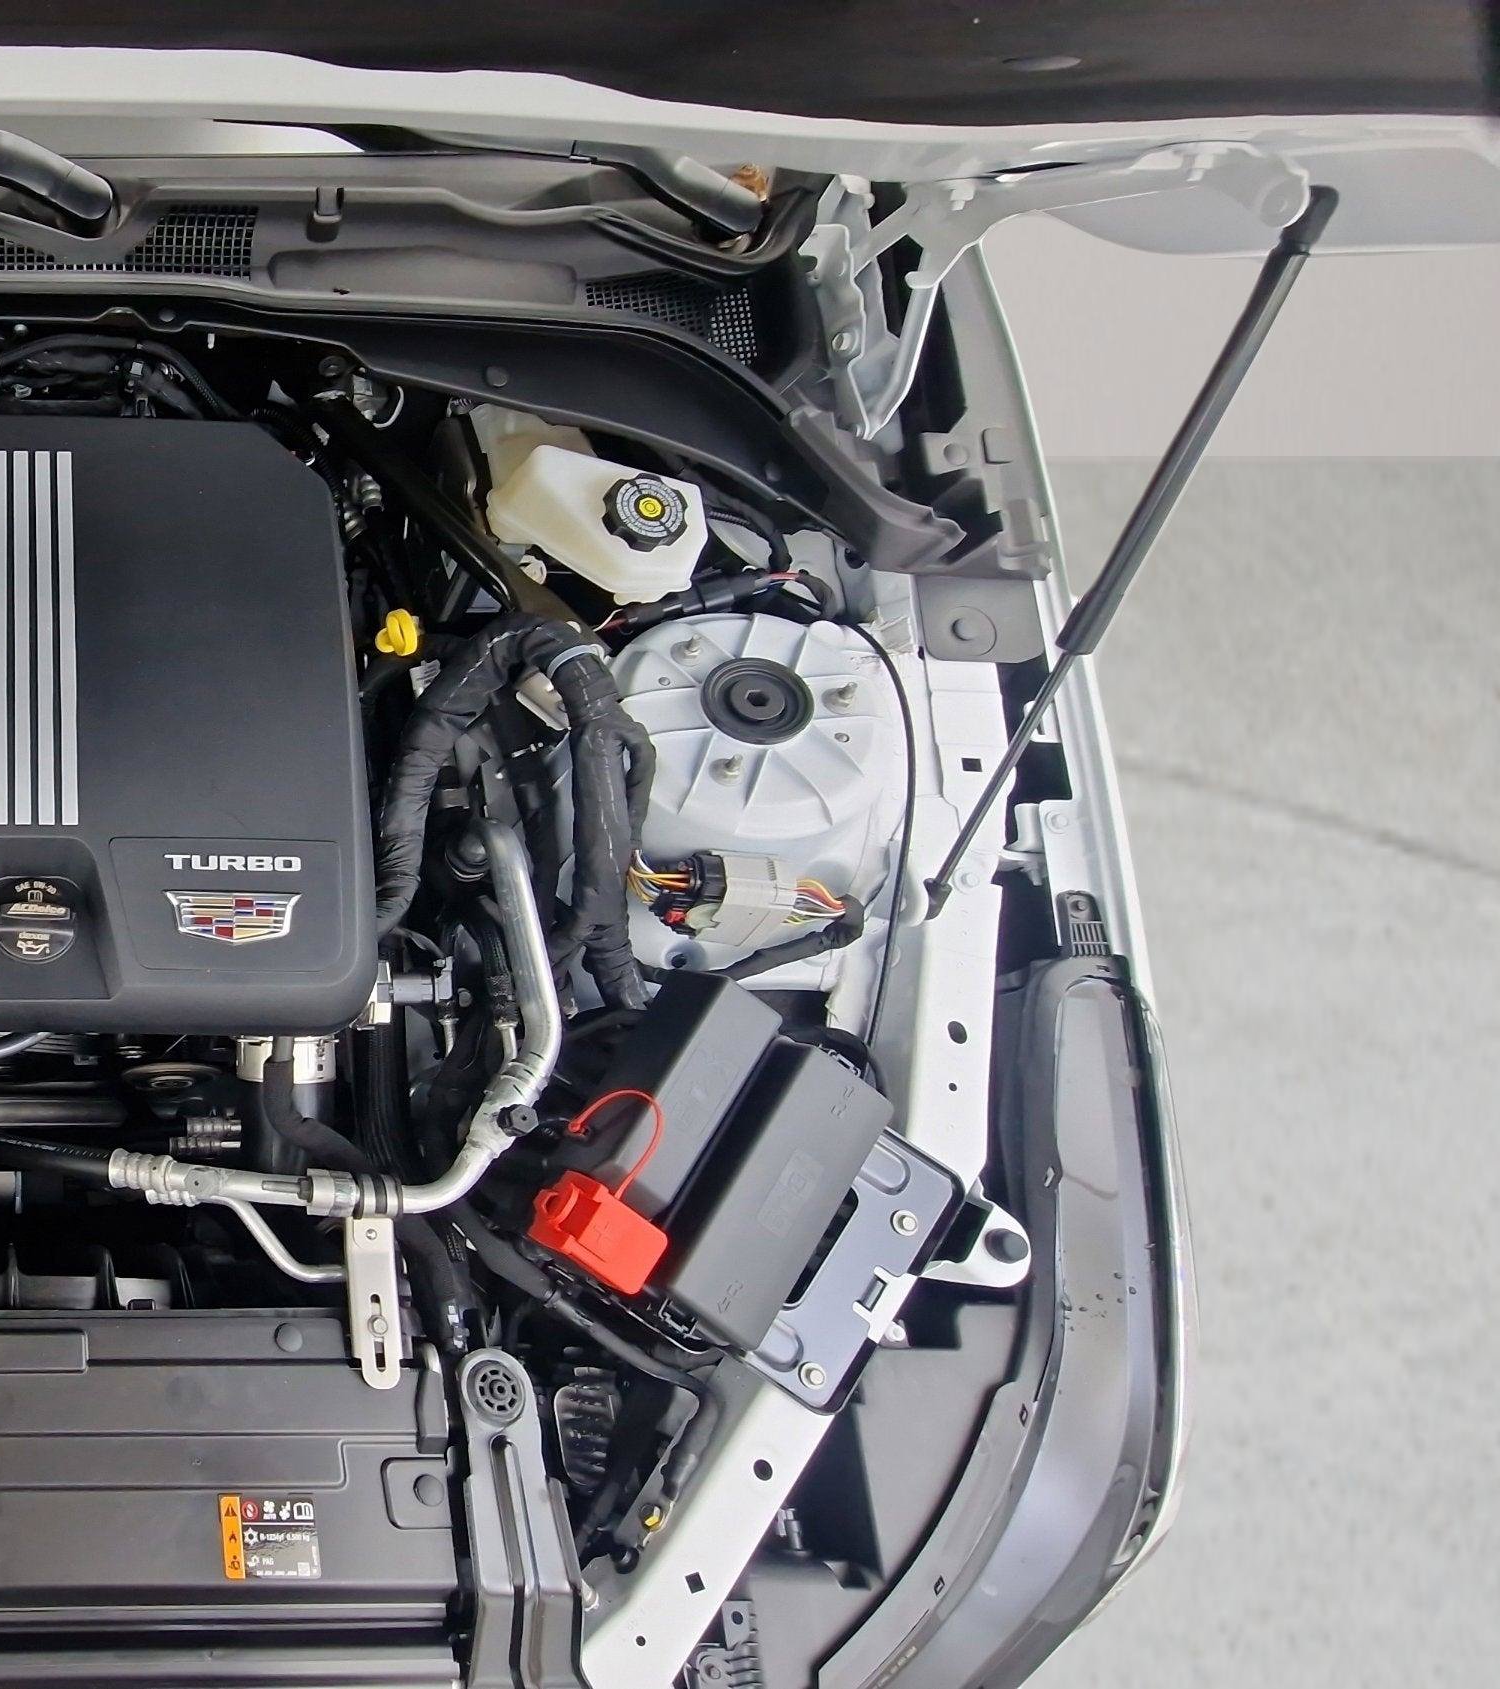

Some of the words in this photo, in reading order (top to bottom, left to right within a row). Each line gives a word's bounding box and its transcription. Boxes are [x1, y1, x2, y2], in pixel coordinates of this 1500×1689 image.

[164, 854, 302, 872] TURBO
[15, 881, 30, 892] SAE
[8, 903, 67, 914] ACDelco
